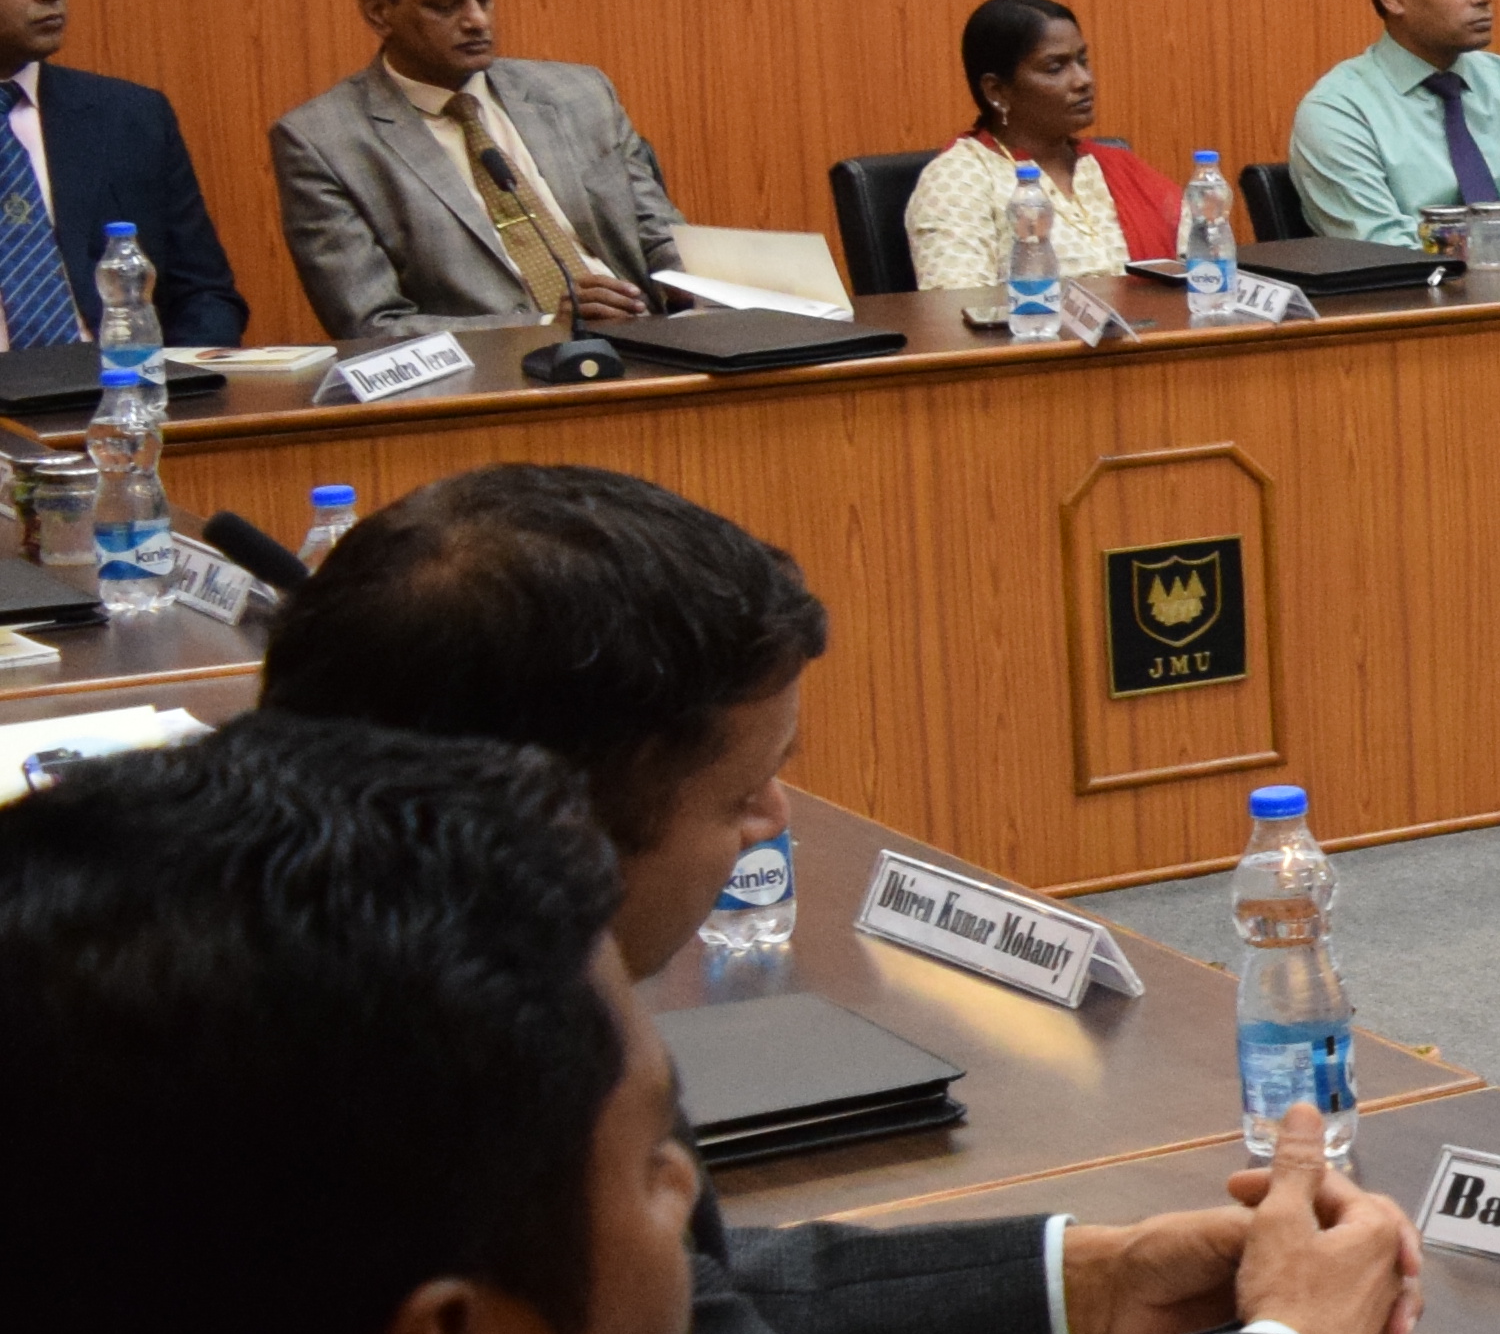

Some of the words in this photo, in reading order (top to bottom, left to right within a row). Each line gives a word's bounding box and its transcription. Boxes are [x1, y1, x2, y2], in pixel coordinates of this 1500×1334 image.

[1147, 650, 1211, 679] JMU
[877, 869, 936, 924] Dhiren
[935, 890, 997, 946] Kumar
[994, 911, 1075, 985] Mohanty
